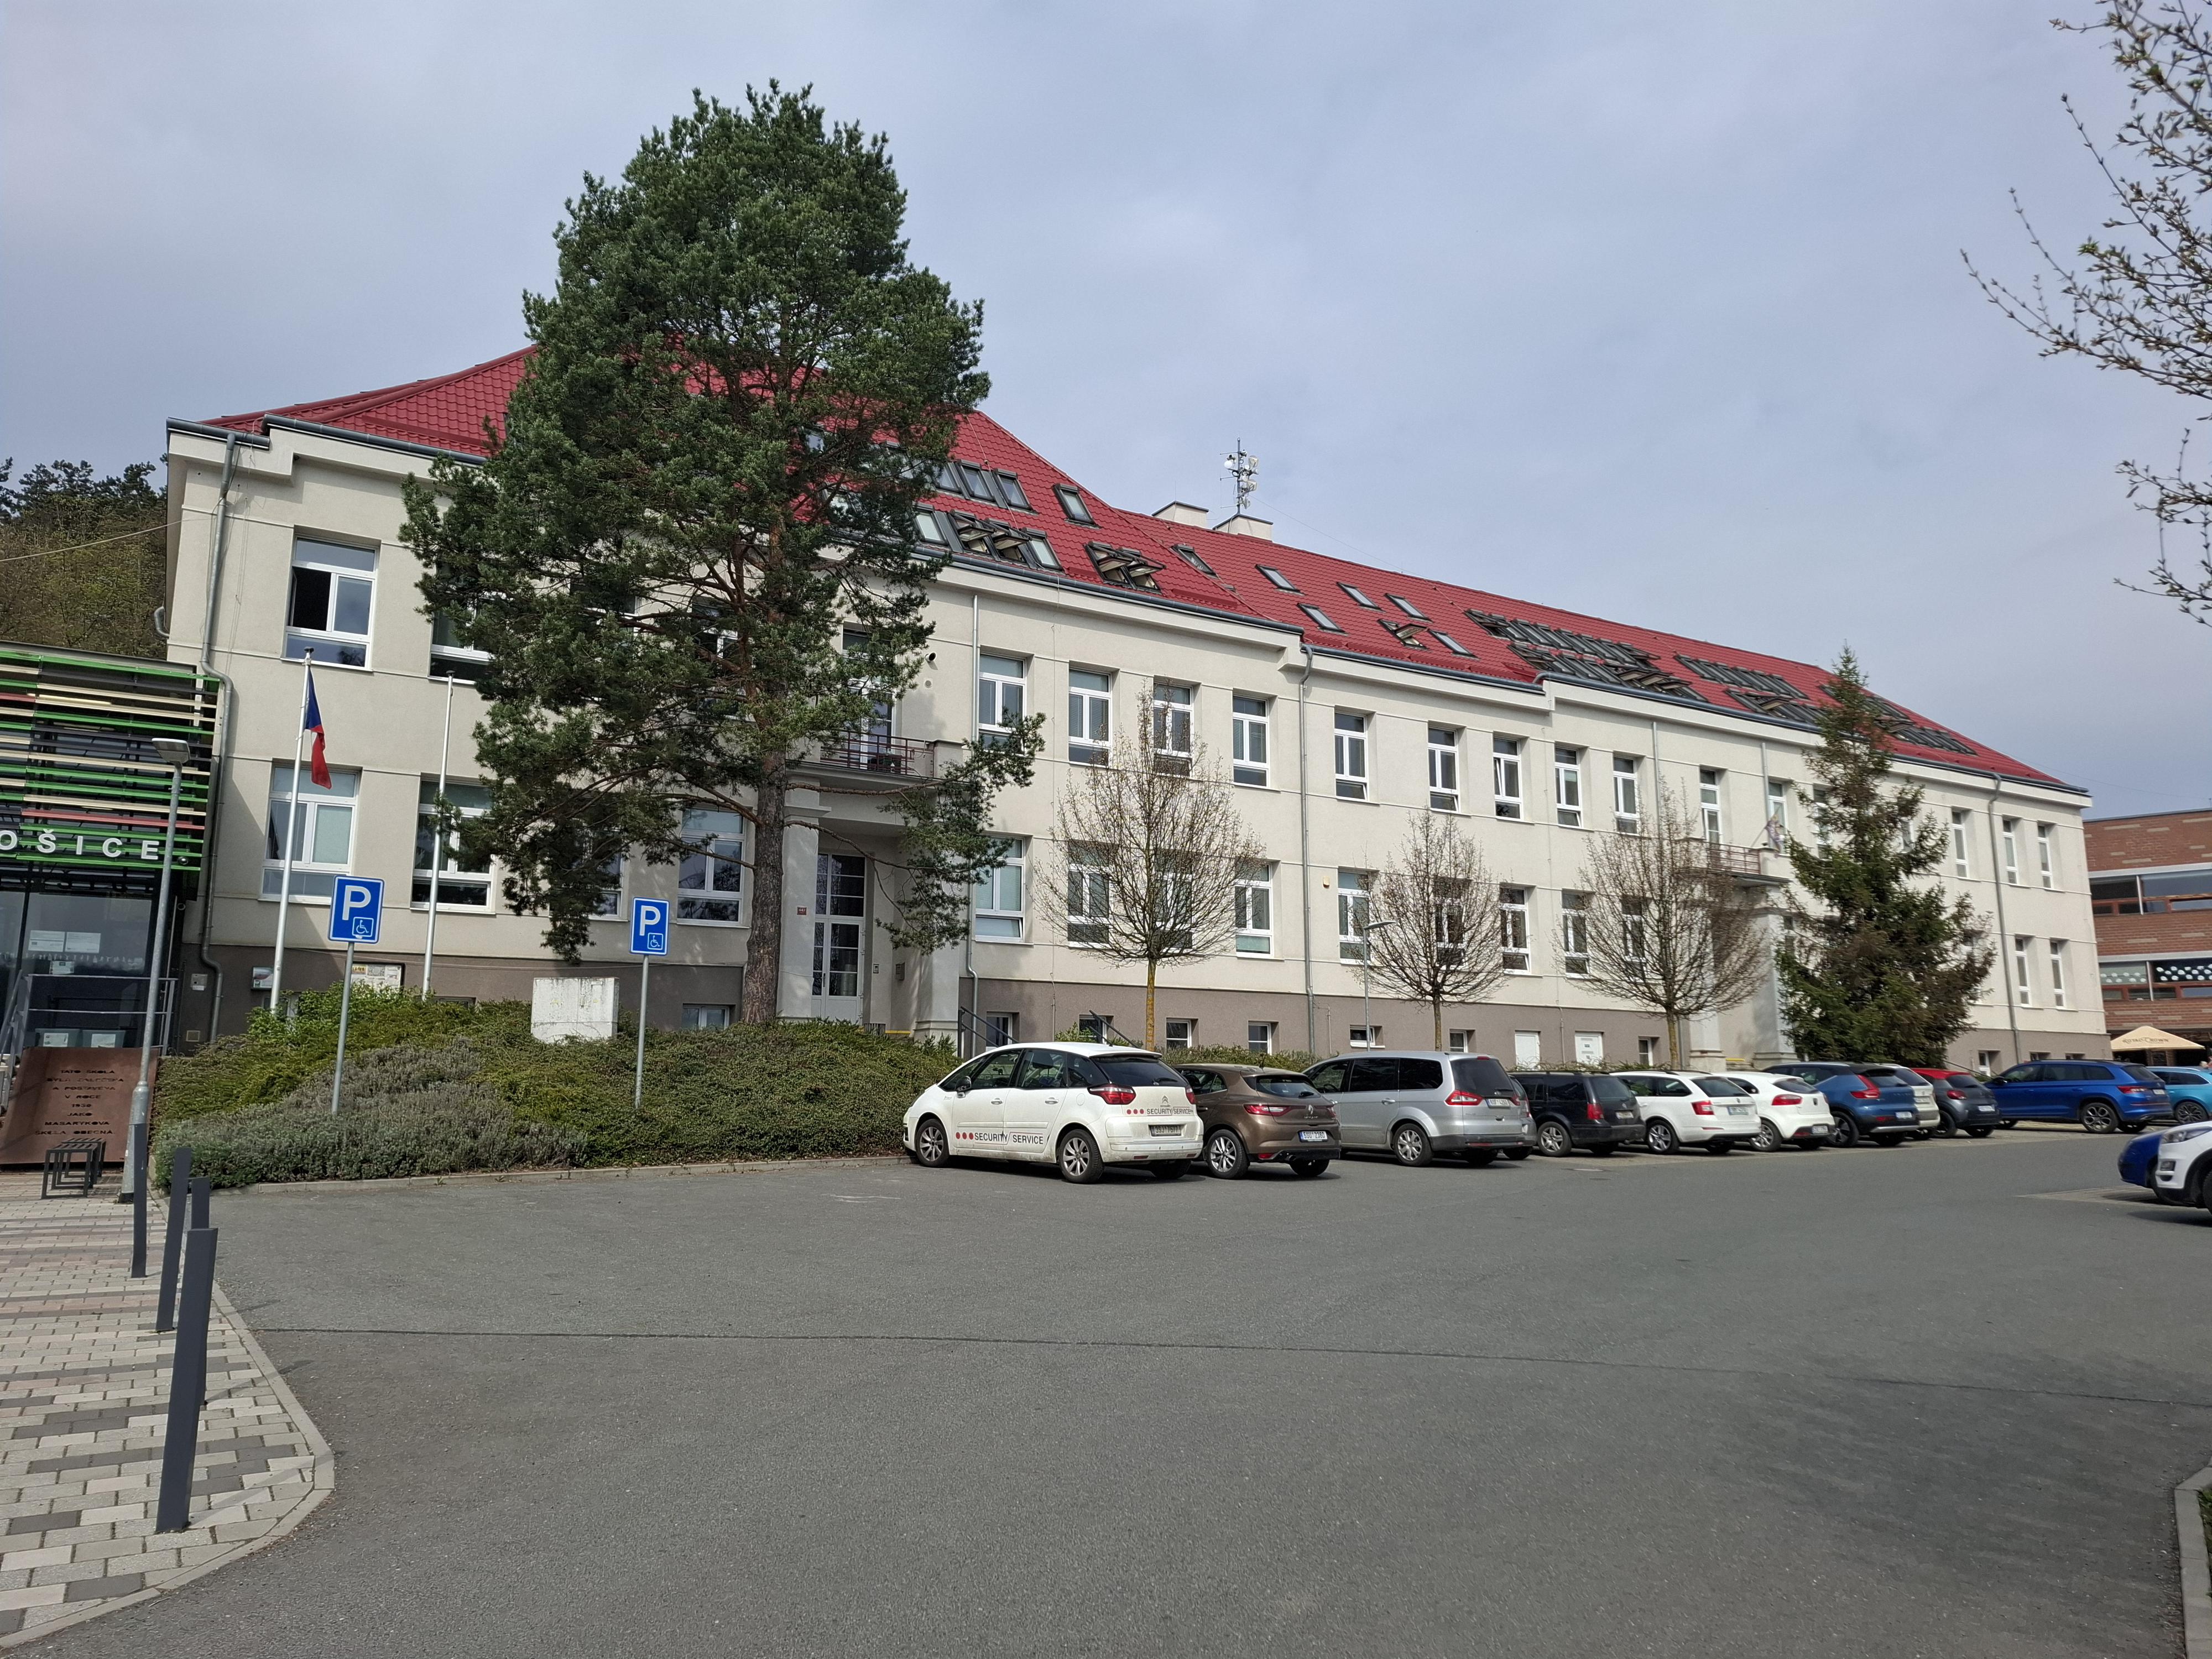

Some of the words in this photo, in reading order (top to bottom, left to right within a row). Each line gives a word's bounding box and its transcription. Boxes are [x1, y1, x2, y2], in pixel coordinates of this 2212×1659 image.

[342, 885, 372, 921] P
[639, 905, 661, 936] P
[974, 1132, 1008, 1142] SECURITY
[1013, 1134, 1044, 1145] SERVICE
